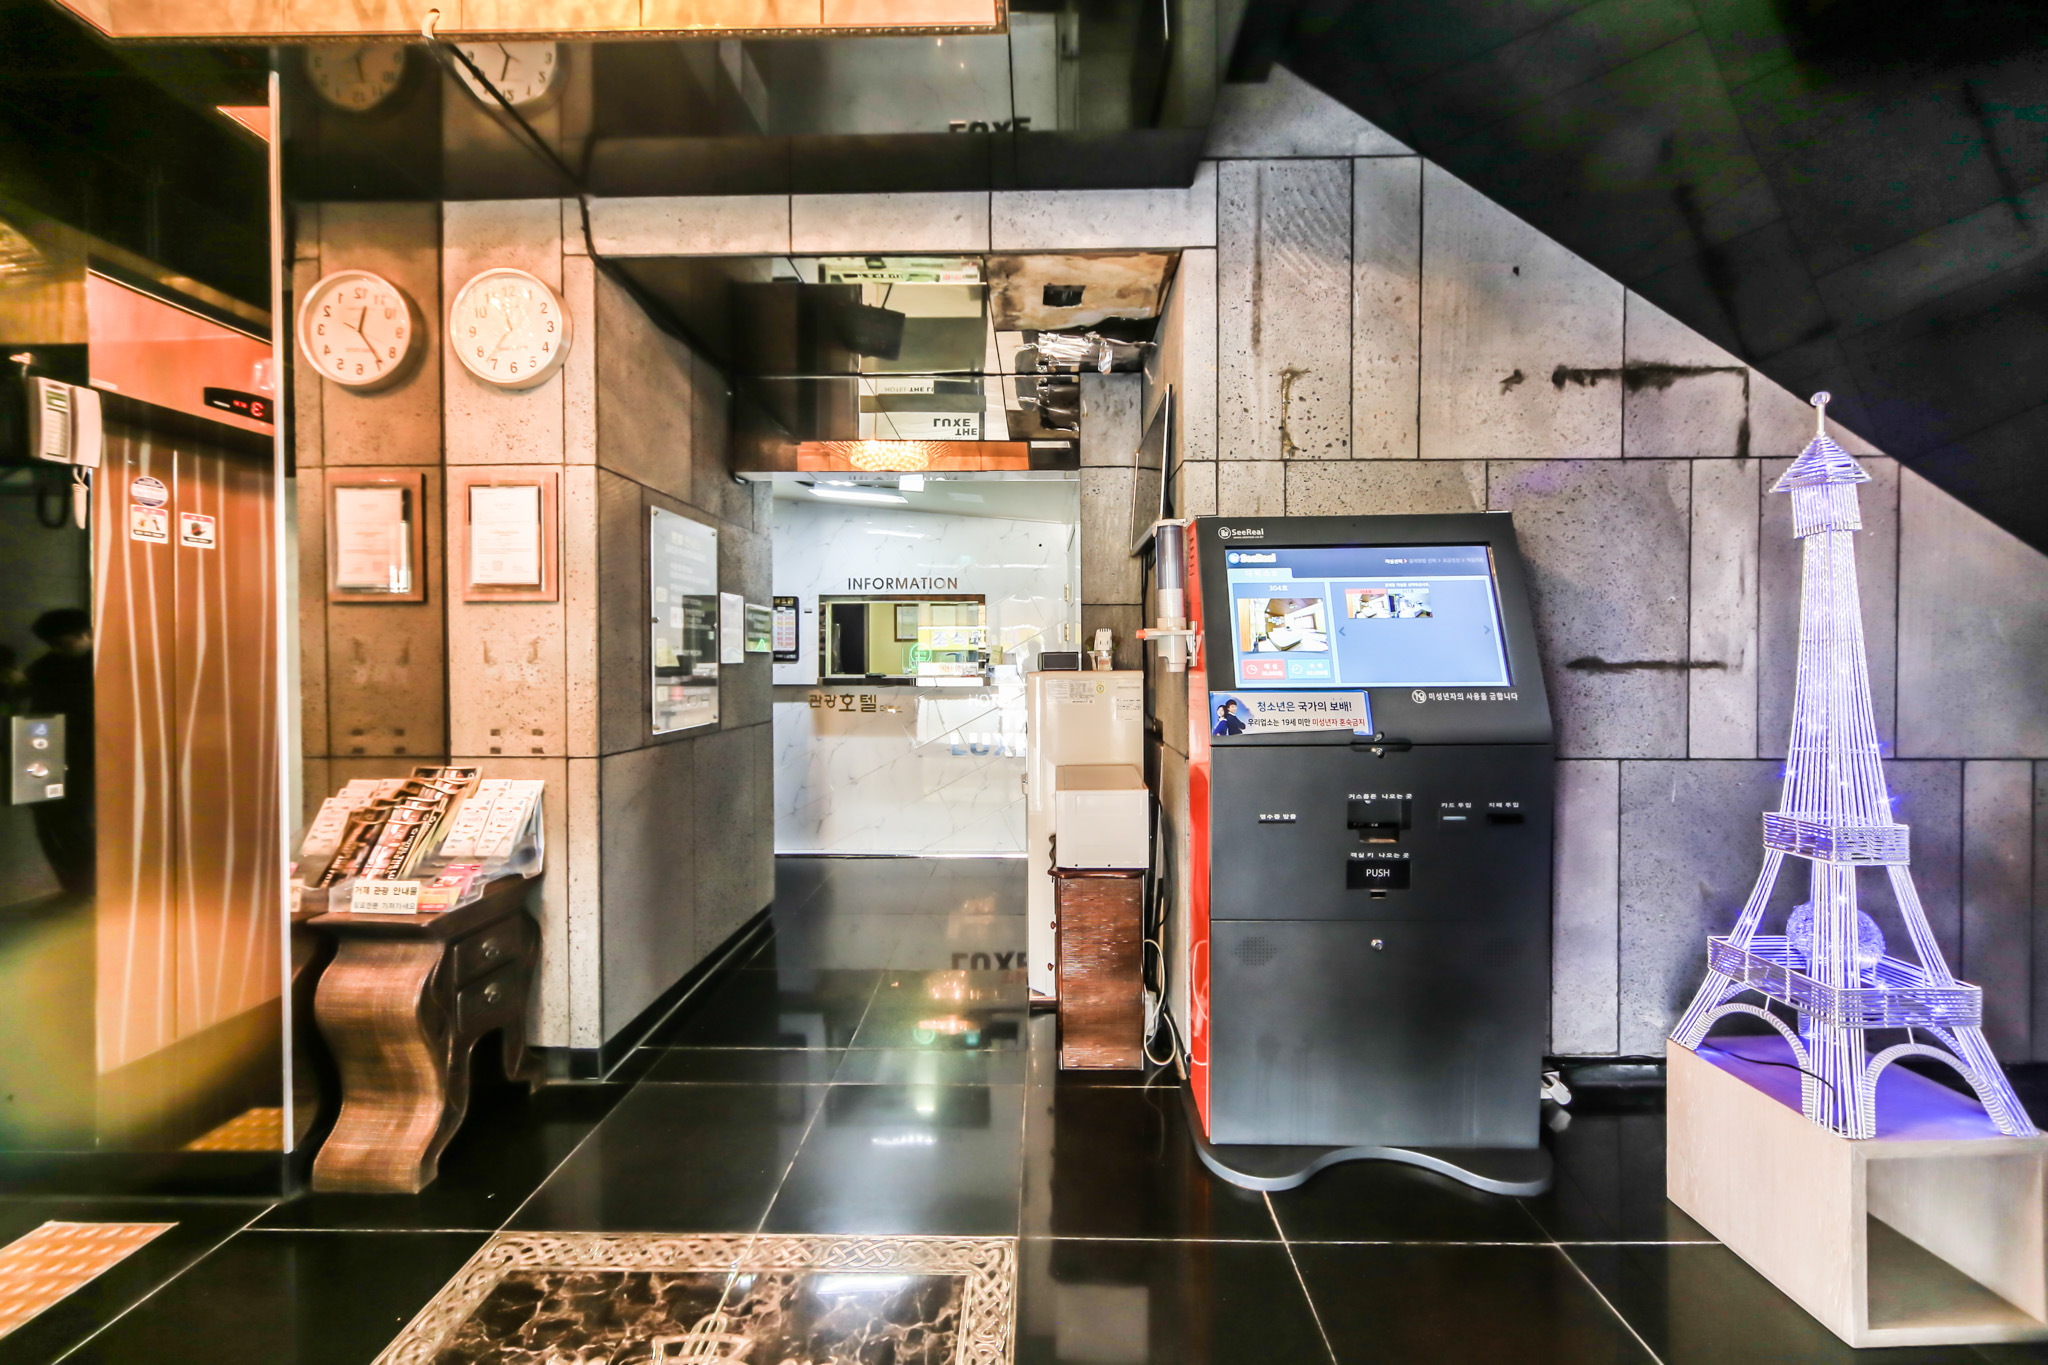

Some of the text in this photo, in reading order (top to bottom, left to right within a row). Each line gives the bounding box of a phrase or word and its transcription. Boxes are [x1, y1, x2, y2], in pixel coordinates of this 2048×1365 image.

[474, 307, 487, 318] 10
[540, 302, 548, 314] 2
[469, 326, 476, 338] 9
[547, 321, 554, 332] 3
[477, 346, 484, 357] 8
[542, 341, 549, 353] 4
[491, 358, 498, 370] 7
[510, 362, 517, 373] 6
[529, 356, 536, 368] 5
[848, 578, 958, 590] INFORMATION
[1428, 692, 1518, 701] 미성년자의 사용을 금합니다
[810, 694, 876, 712] 관광호텔
[1257, 701, 1352, 712] 청소년은 국가의 보배!
[1248, 718, 1365, 727] 우리업소는 19세 미만 미성년자 혼숙금지
[1366, 869, 1390, 877] PUSH
[355, 886, 370, 895] 거제
[374, 886, 389, 895] 관광
